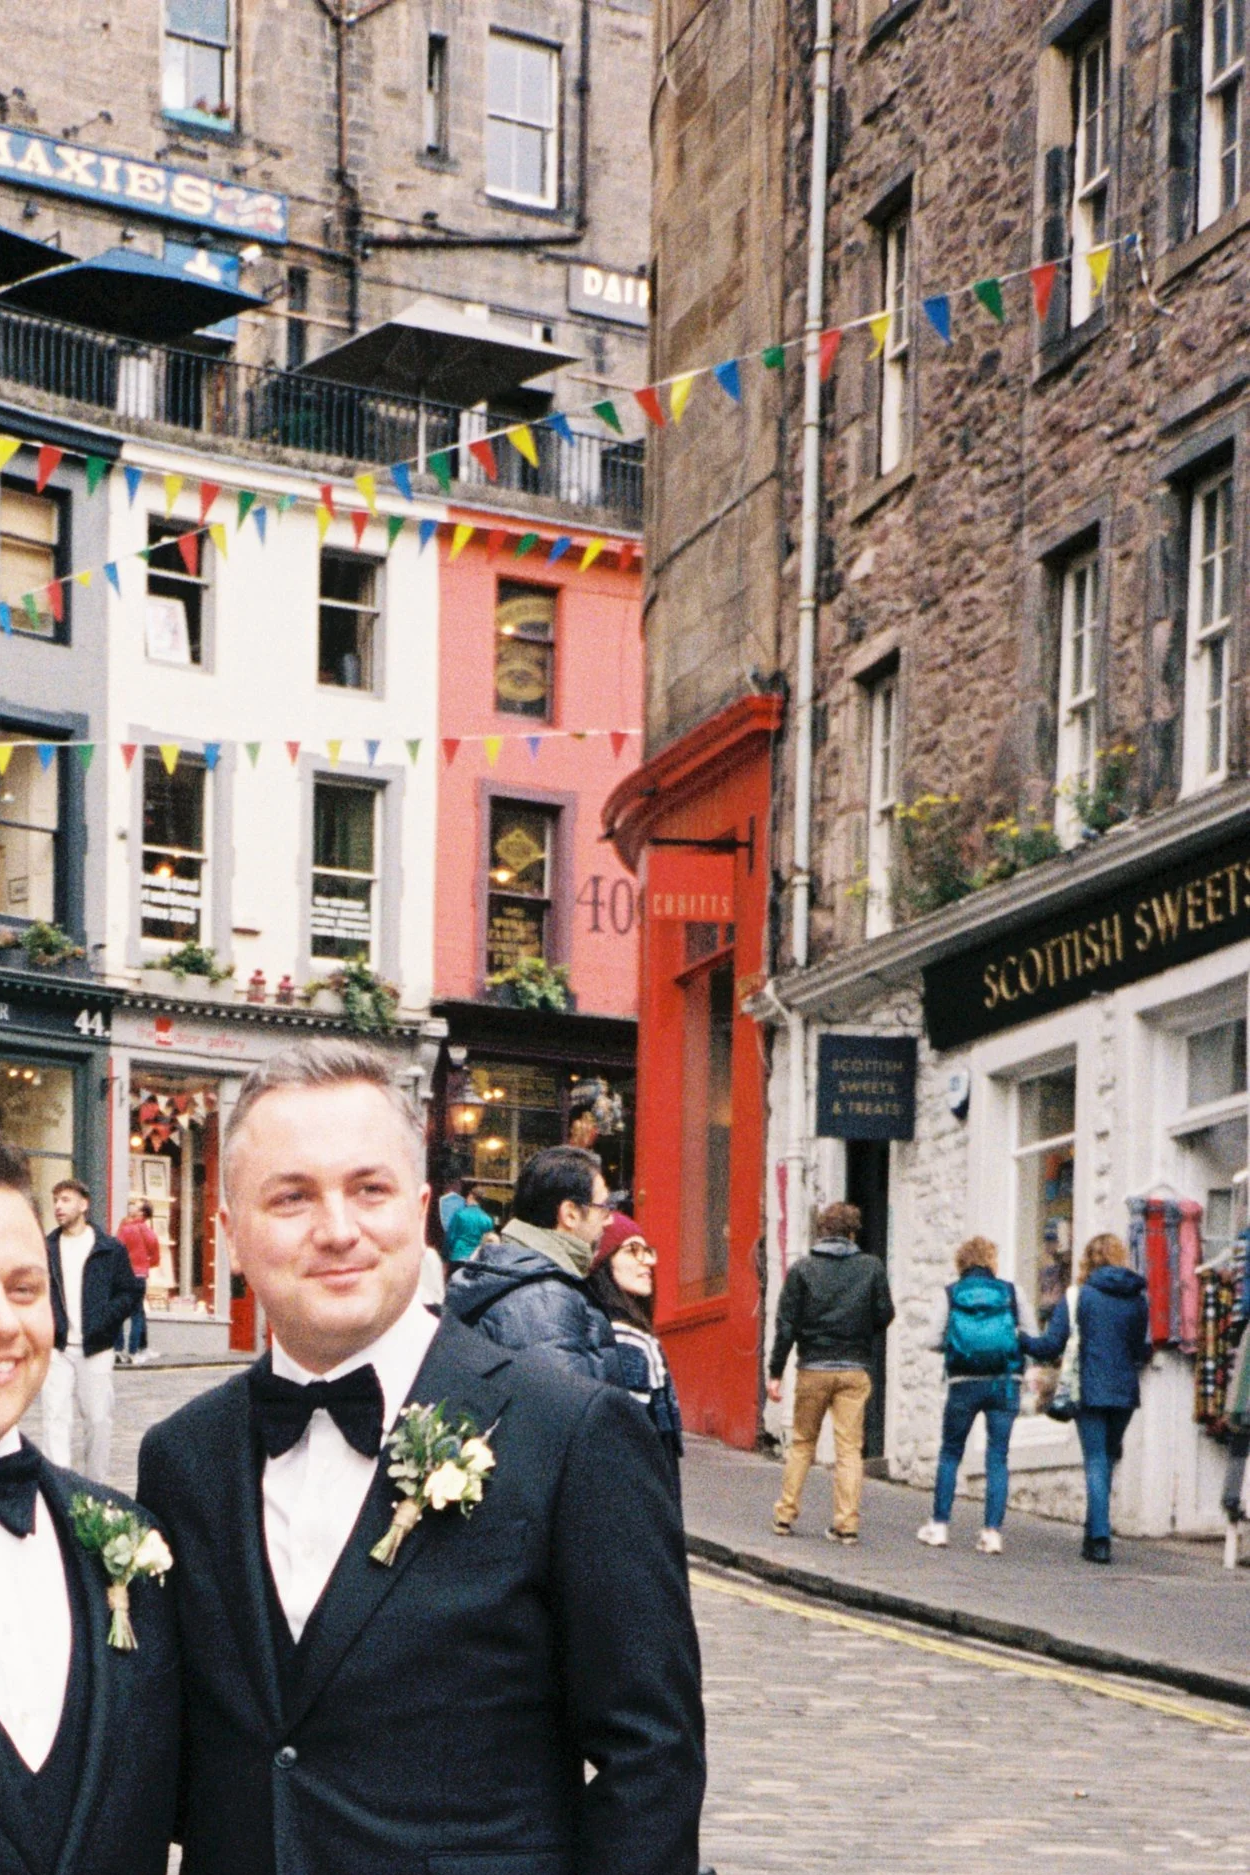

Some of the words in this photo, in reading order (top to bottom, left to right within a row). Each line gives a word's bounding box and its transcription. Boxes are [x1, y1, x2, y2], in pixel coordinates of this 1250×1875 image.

[575, 874, 634, 935] 40
[982, 912, 1124, 1010] SCOTTISH
[74, 1008, 111, 1038] 44.
[831, 1058, 903, 1073] SCOTTISH
[837, 1081, 896, 1095] SWEETS
[832, 1101, 841, 1115] &
[847, 1101, 903, 1117] TREATS
